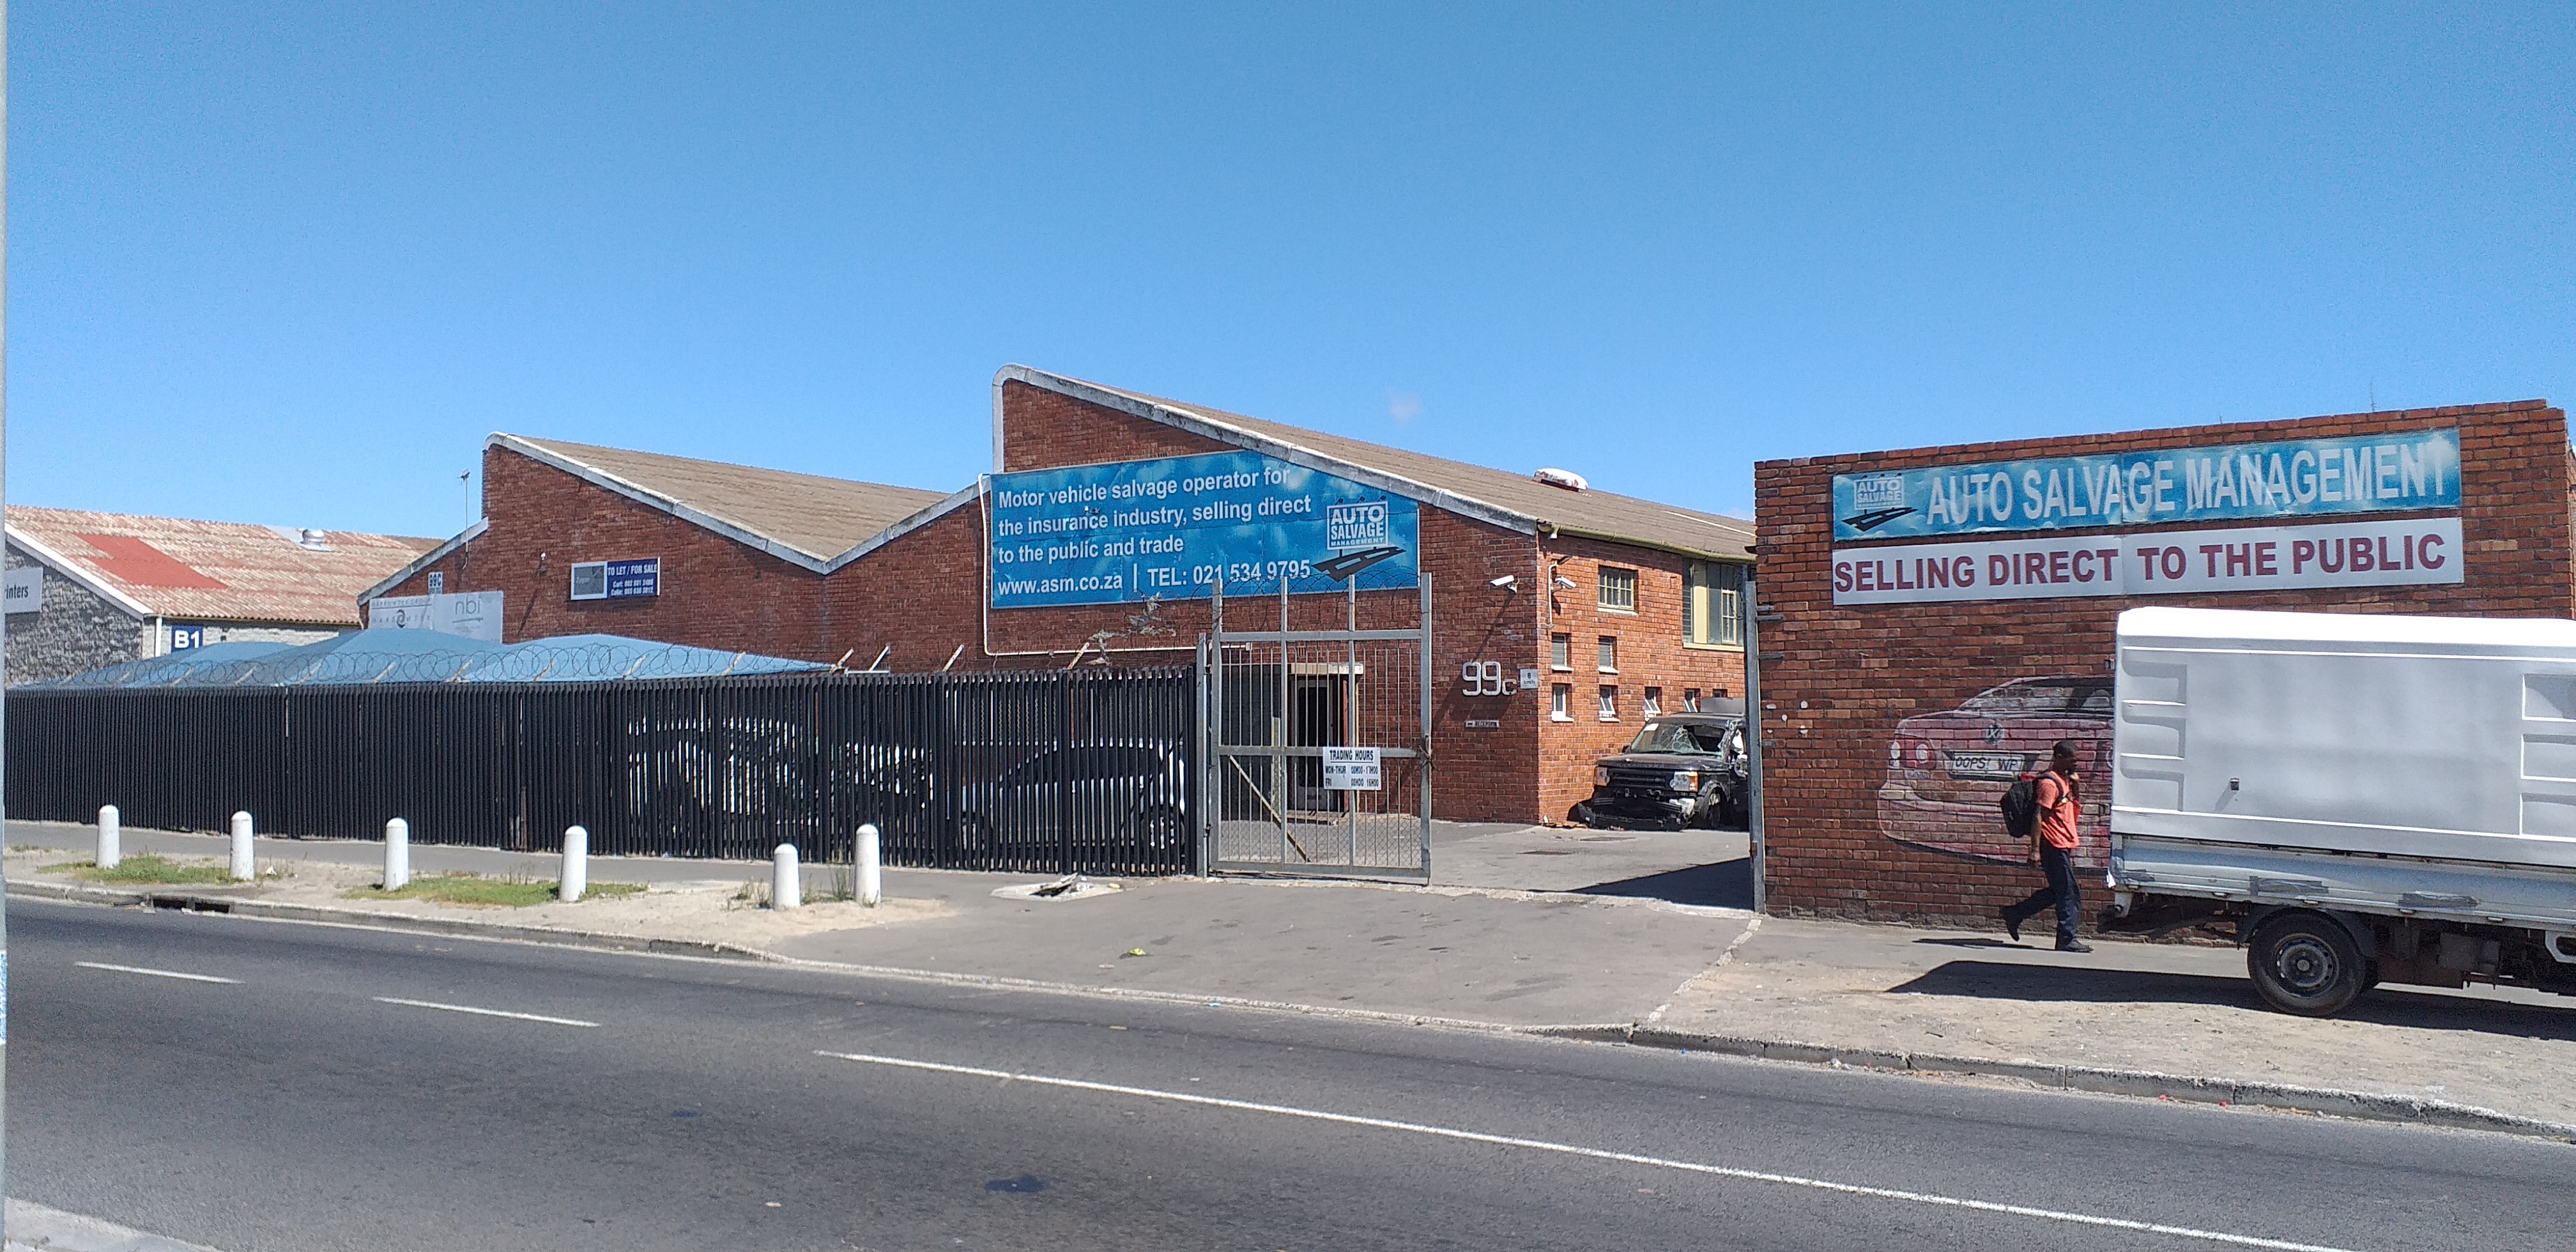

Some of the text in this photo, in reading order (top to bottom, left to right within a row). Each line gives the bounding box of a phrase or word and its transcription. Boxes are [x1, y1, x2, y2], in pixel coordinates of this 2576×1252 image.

[999, 467, 1290, 508] Motor vehicle salvage operator for
[1857, 480, 1900, 492] AUTO
[1926, 443, 2448, 525] AUTO SALVAGE MANAGEMENT
[1857, 491, 1901, 503] SALVAGE
[999, 494, 1311, 536] the insurance industry, selling direct
[1331, 505, 1384, 524] AUTO
[1331, 522, 1384, 540] SALVAGE
[999, 535, 1184, 564] to the public and trade
[1331, 538, 1384, 546] MANAGEMENT
[608, 567, 615, 576] TO
[616, 565, 626, 576] LET
[631, 565, 643, 574] FOR
[643, 563, 657, 574] SALE
[1834, 534, 2446, 592] SELLING DIRECT TO THE PUBLIC
[998, 560, 1310, 595] www.asm.co.za TEL: 021 534 9795
[174, 630, 199, 648] B1
[1330, 750, 1374, 761] TRADING HOURS
